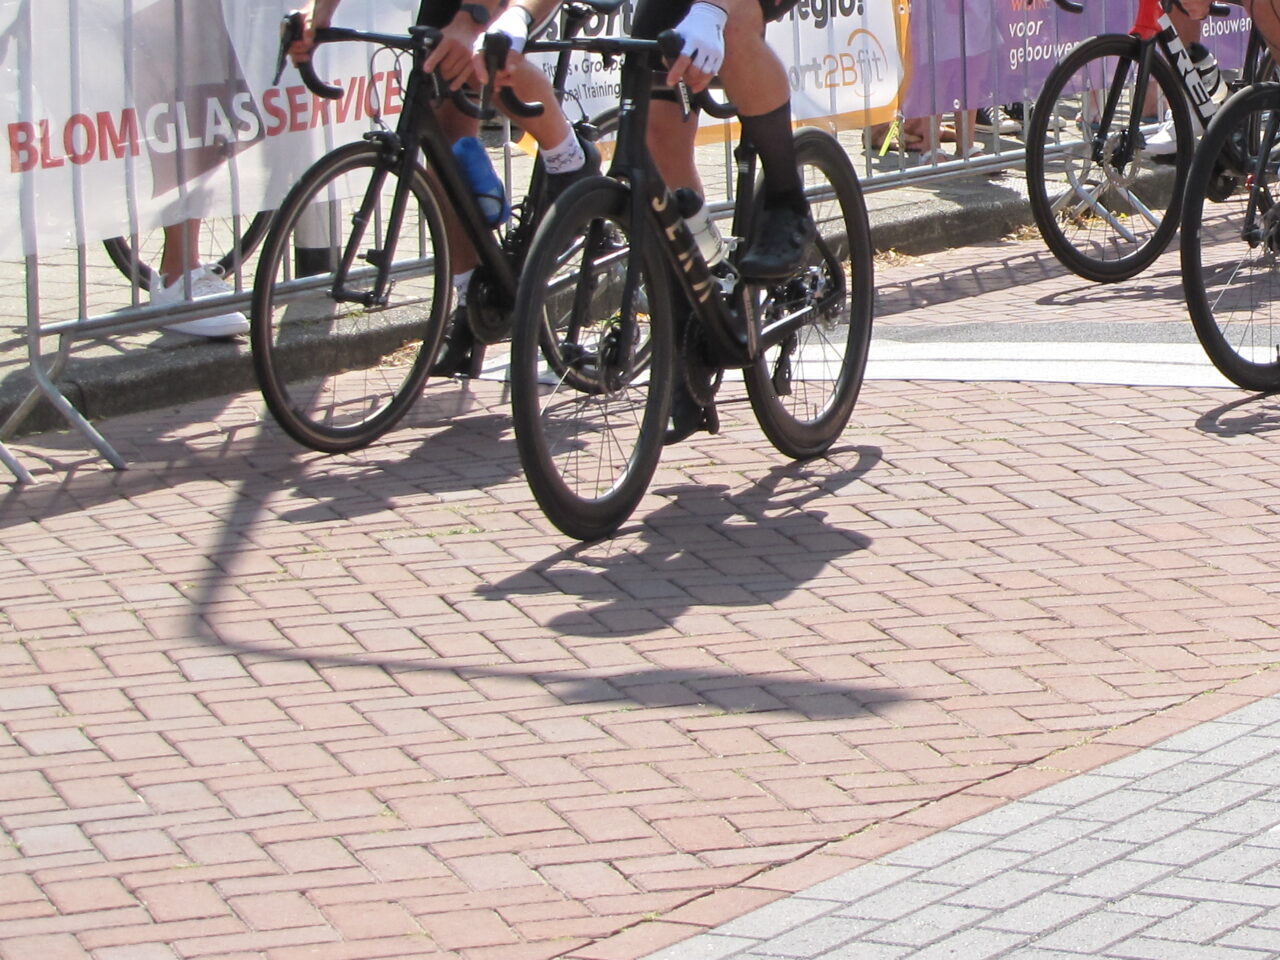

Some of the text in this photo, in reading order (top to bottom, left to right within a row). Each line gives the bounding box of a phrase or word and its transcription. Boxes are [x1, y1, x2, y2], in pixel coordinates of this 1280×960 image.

[1009, 19, 1043, 37] voor
[1202, 16, 1252, 37] ebouwen
[788, 48, 884, 92] ort2Bfit
[582, 81, 621, 100] Training
